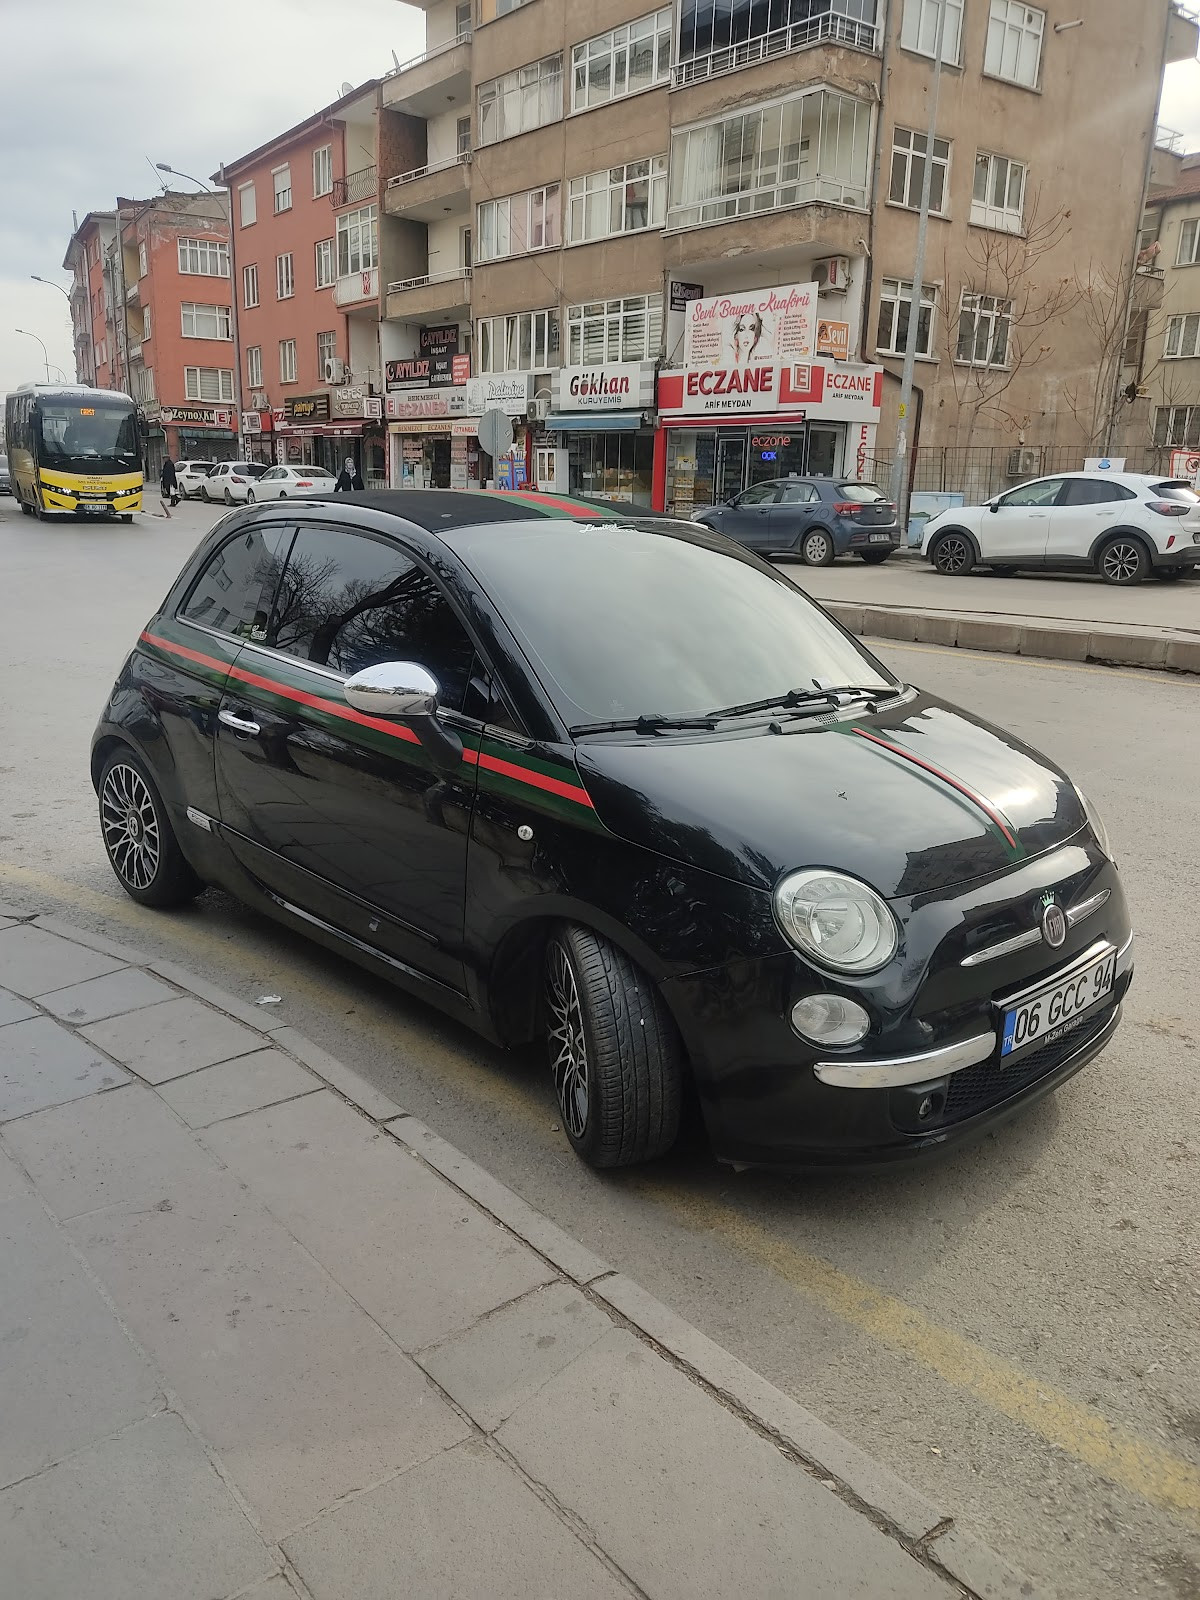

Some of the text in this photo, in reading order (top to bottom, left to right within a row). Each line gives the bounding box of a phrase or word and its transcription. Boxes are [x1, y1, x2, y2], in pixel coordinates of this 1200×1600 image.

[692, 300, 719, 321] Sevil
[720, 300, 755, 319] Bayan
[821, 325, 847, 345] Sevil
[396, 360, 430, 378] AYYILDIZ
[796, 368, 807, 386] E
[569, 372, 630, 396] Gökhan
[687, 366, 773, 396] ECZANE
[827, 373, 872, 392] ECZANE
[336, 388, 362, 400] NEFES
[721, 400, 752, 408] MEYDAN
[1014, 1002, 1042, 1044] 06
[1048, 975, 1088, 1025] GCC
[1092, 958, 1112, 998] 94
